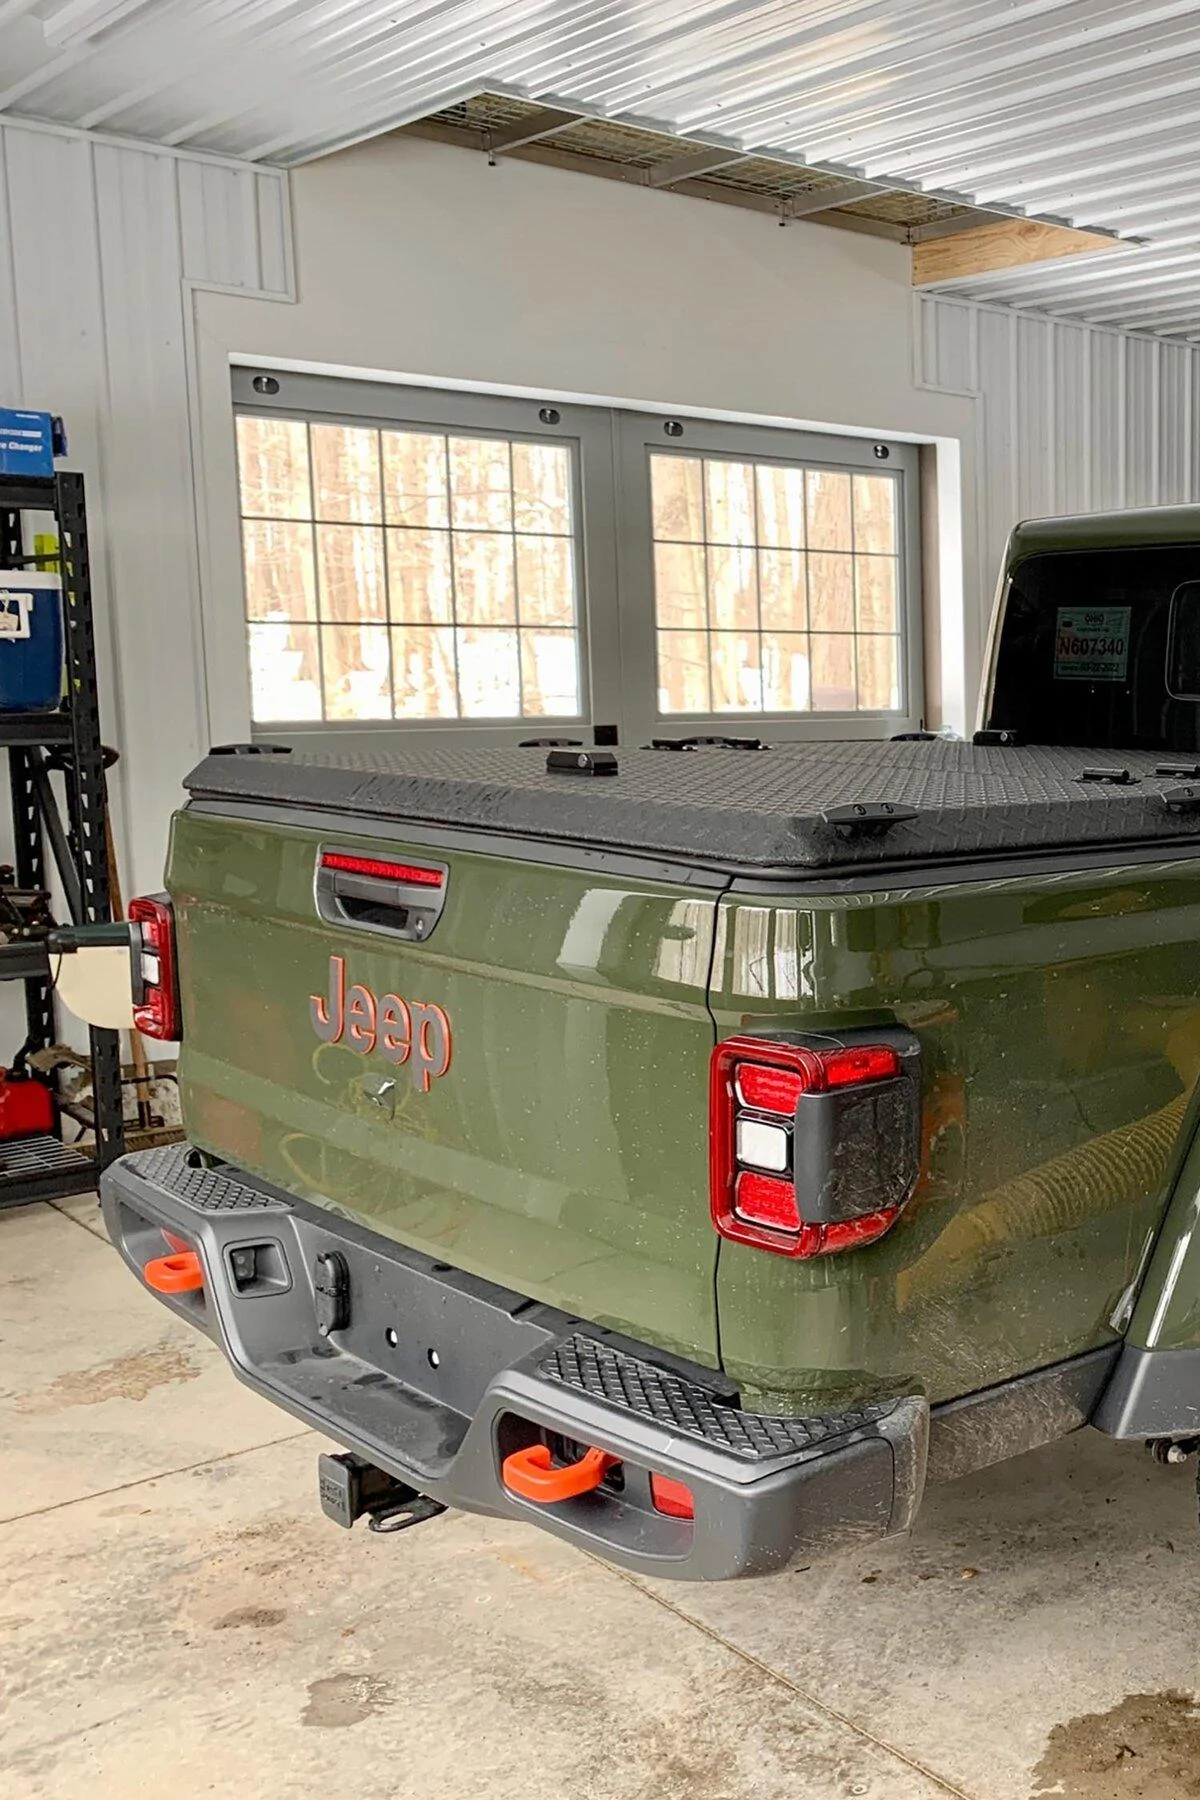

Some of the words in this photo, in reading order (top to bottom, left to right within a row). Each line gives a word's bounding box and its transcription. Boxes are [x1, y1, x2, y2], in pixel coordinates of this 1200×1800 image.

[8, 441, 44, 453] Changer
[1059, 637, 1124, 655] N607340
[309, 955, 453, 1094] Jeep
